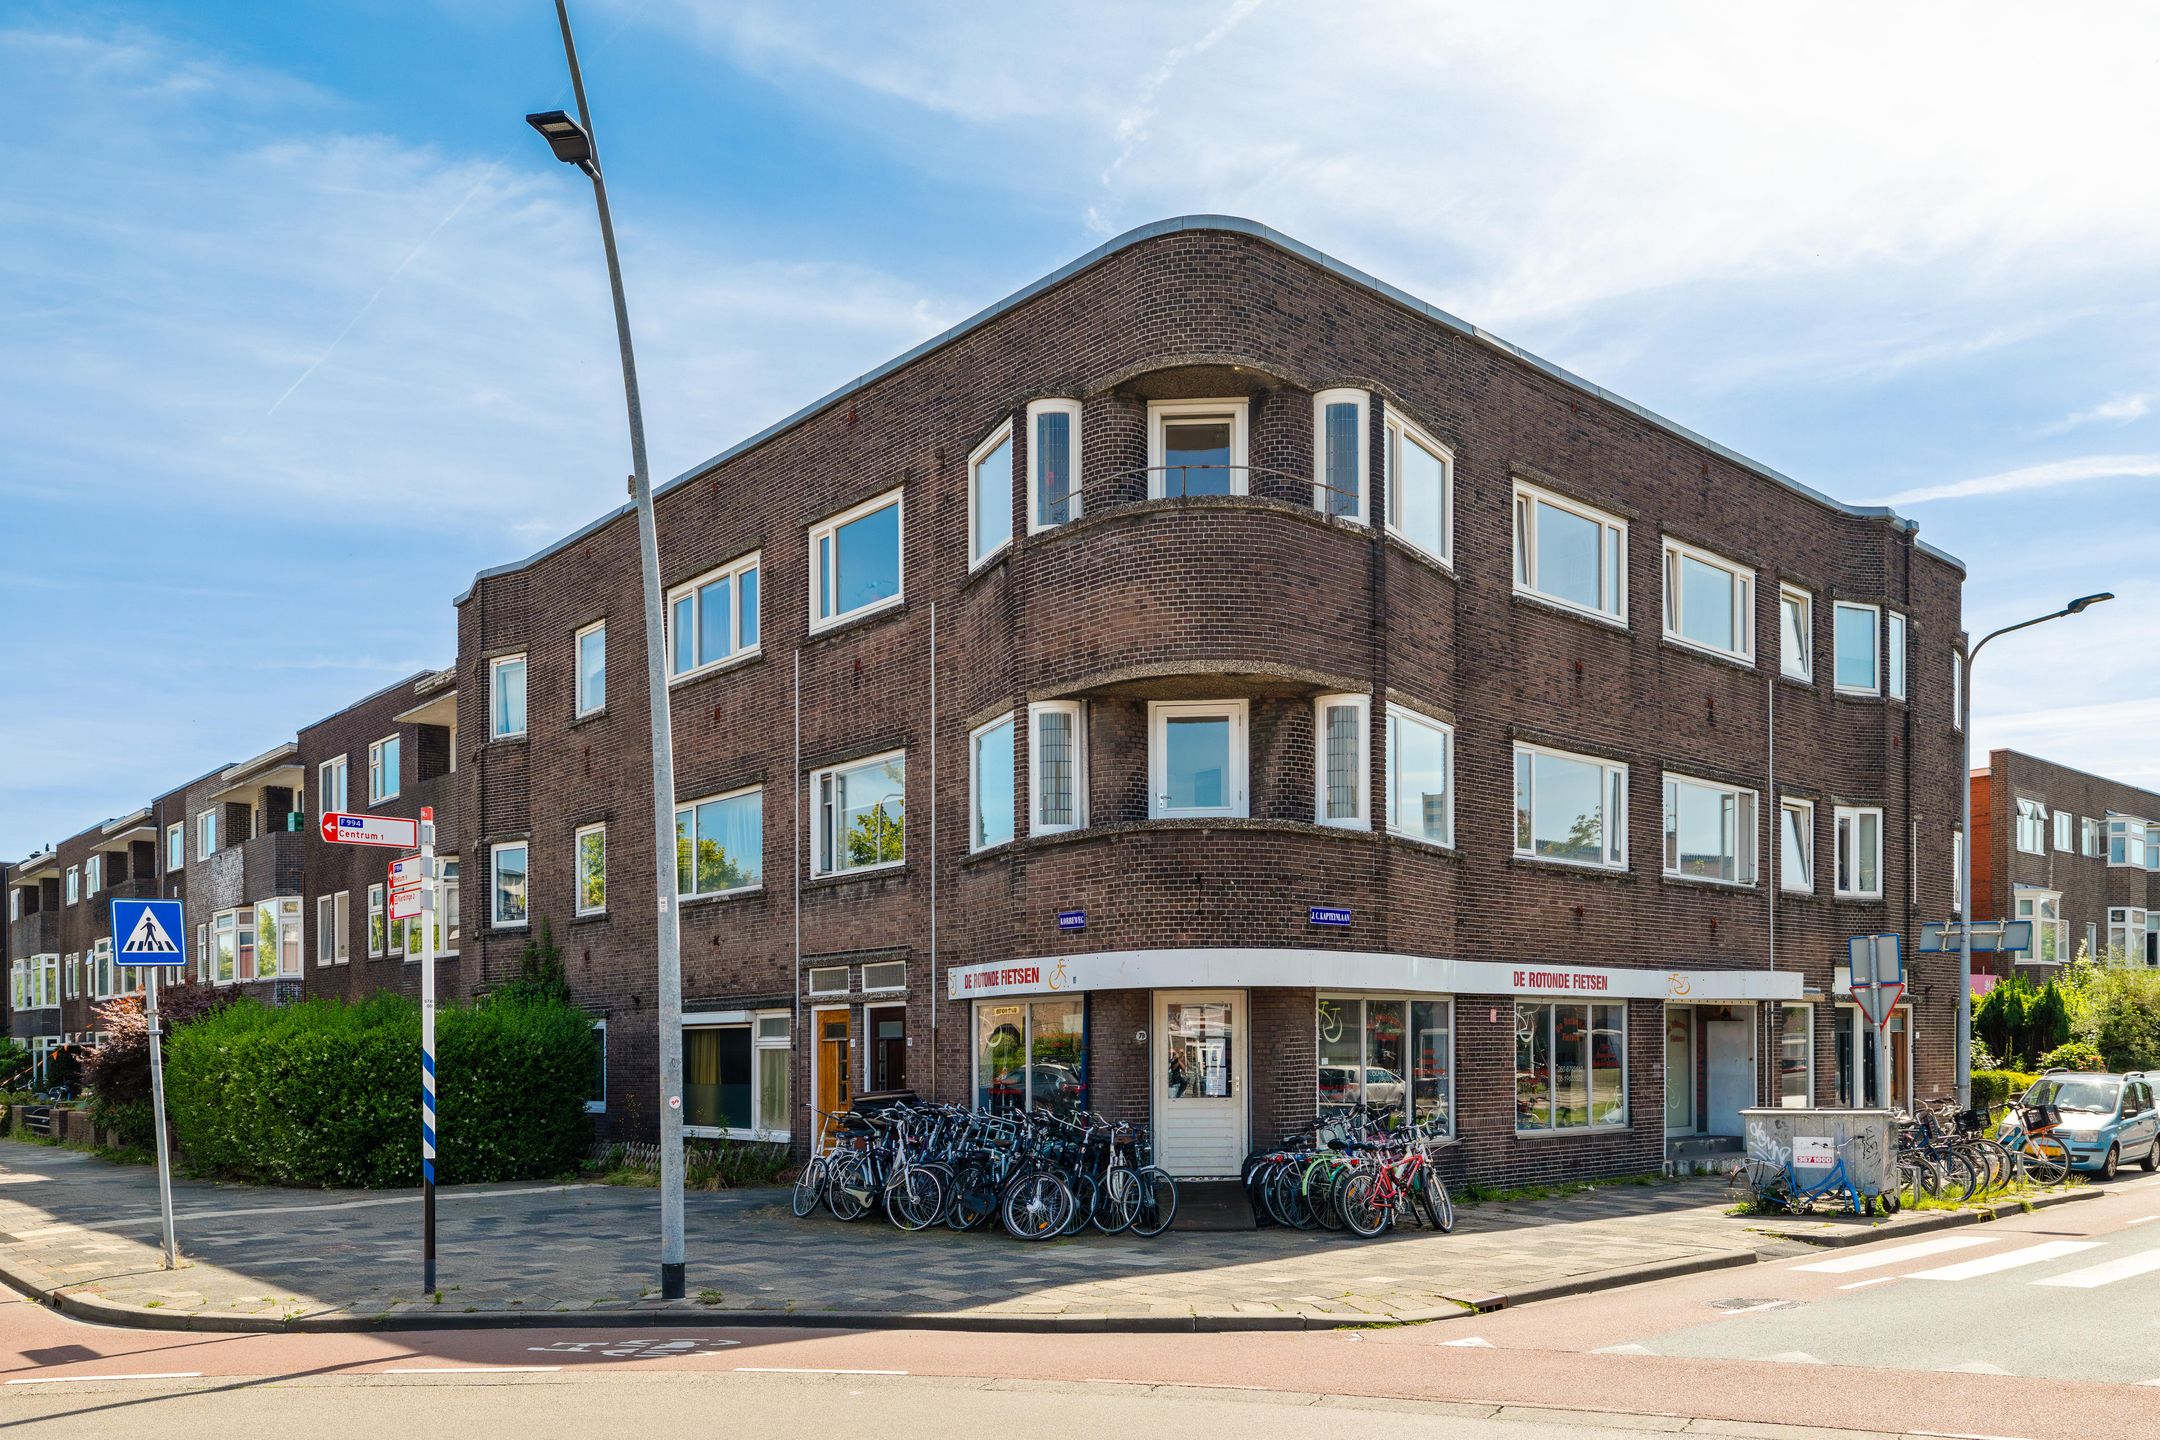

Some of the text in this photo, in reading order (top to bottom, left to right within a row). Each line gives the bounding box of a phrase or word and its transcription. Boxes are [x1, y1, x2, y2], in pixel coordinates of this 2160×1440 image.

[339, 830, 378, 840] Centrum
[964, 967, 1040, 989] DE ROTONDE FIETSEN
[1513, 971, 1608, 990] DE ROTONDE FIETSEN
